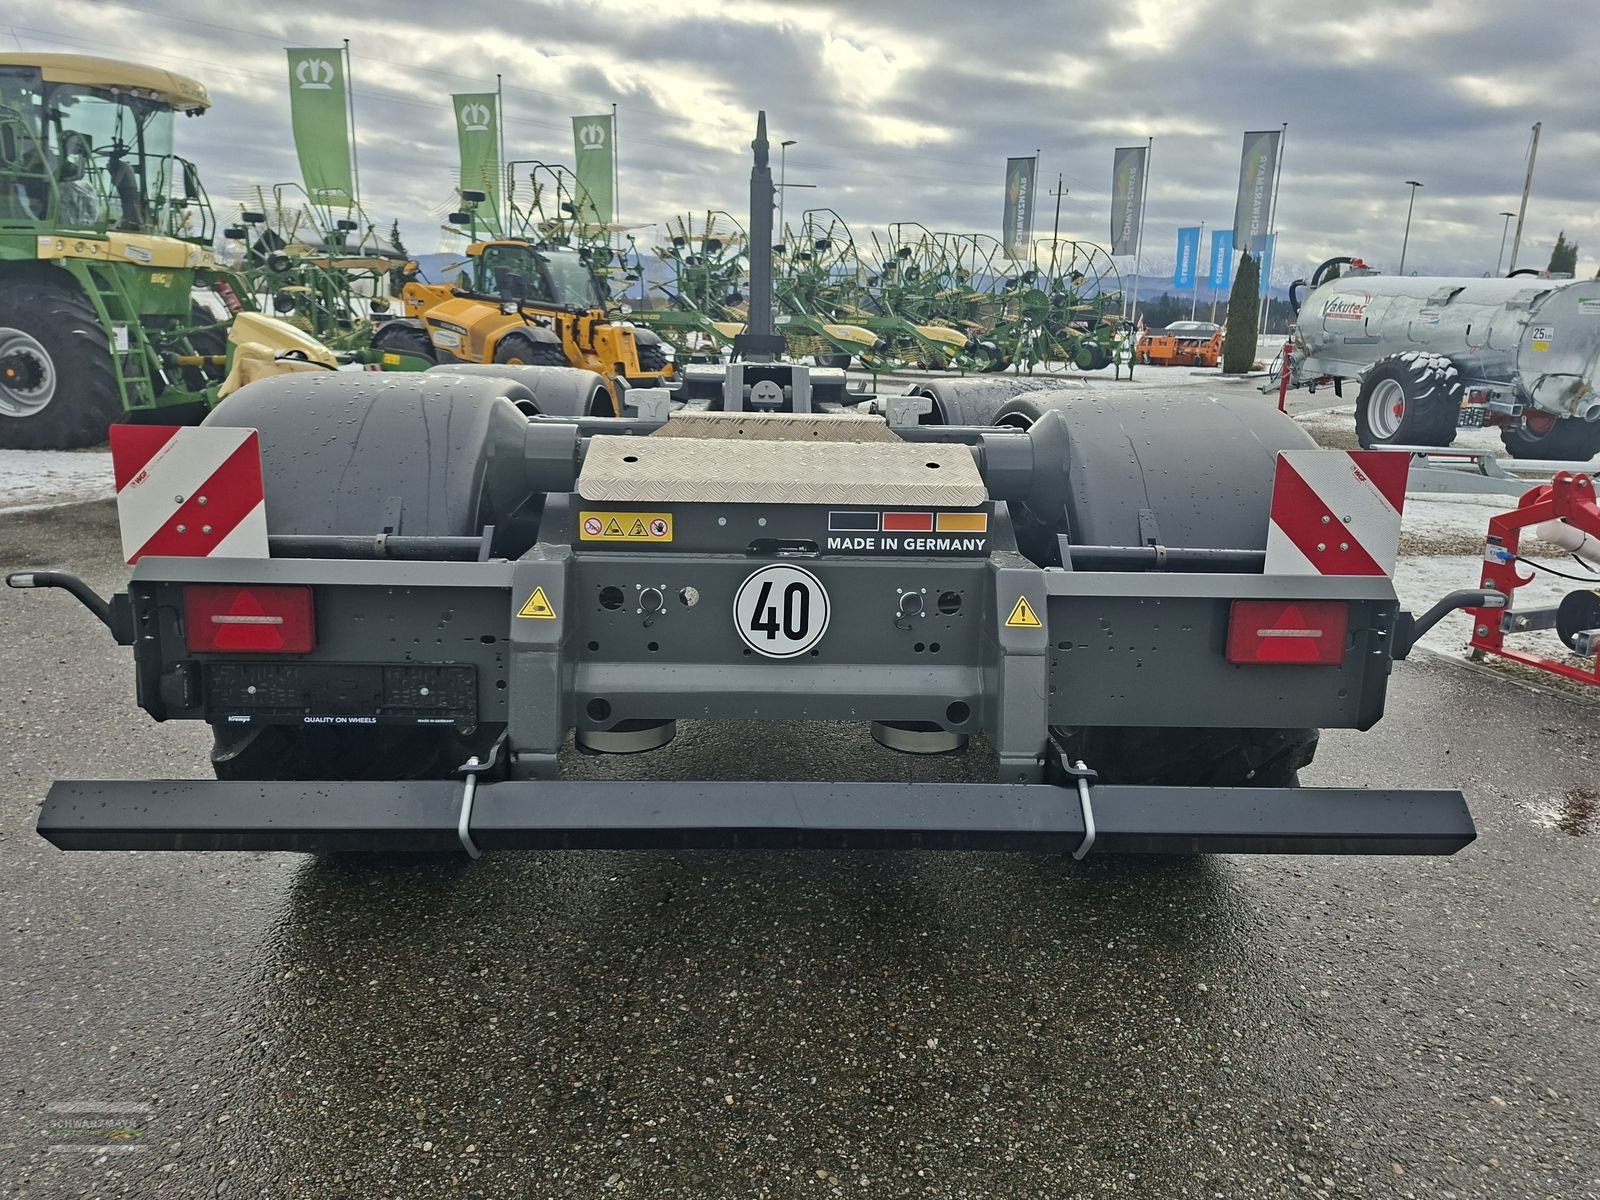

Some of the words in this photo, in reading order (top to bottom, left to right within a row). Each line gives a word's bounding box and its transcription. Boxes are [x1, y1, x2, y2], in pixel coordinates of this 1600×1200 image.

[1321, 297, 1367, 317] Vakutec
[1533, 327, 1545, 340] 25
[827, 537, 875, 550] MADE
[881, 538, 898, 550] IN
[903, 538, 986, 551] GERMANY
[750, 581, 810, 641] 40
